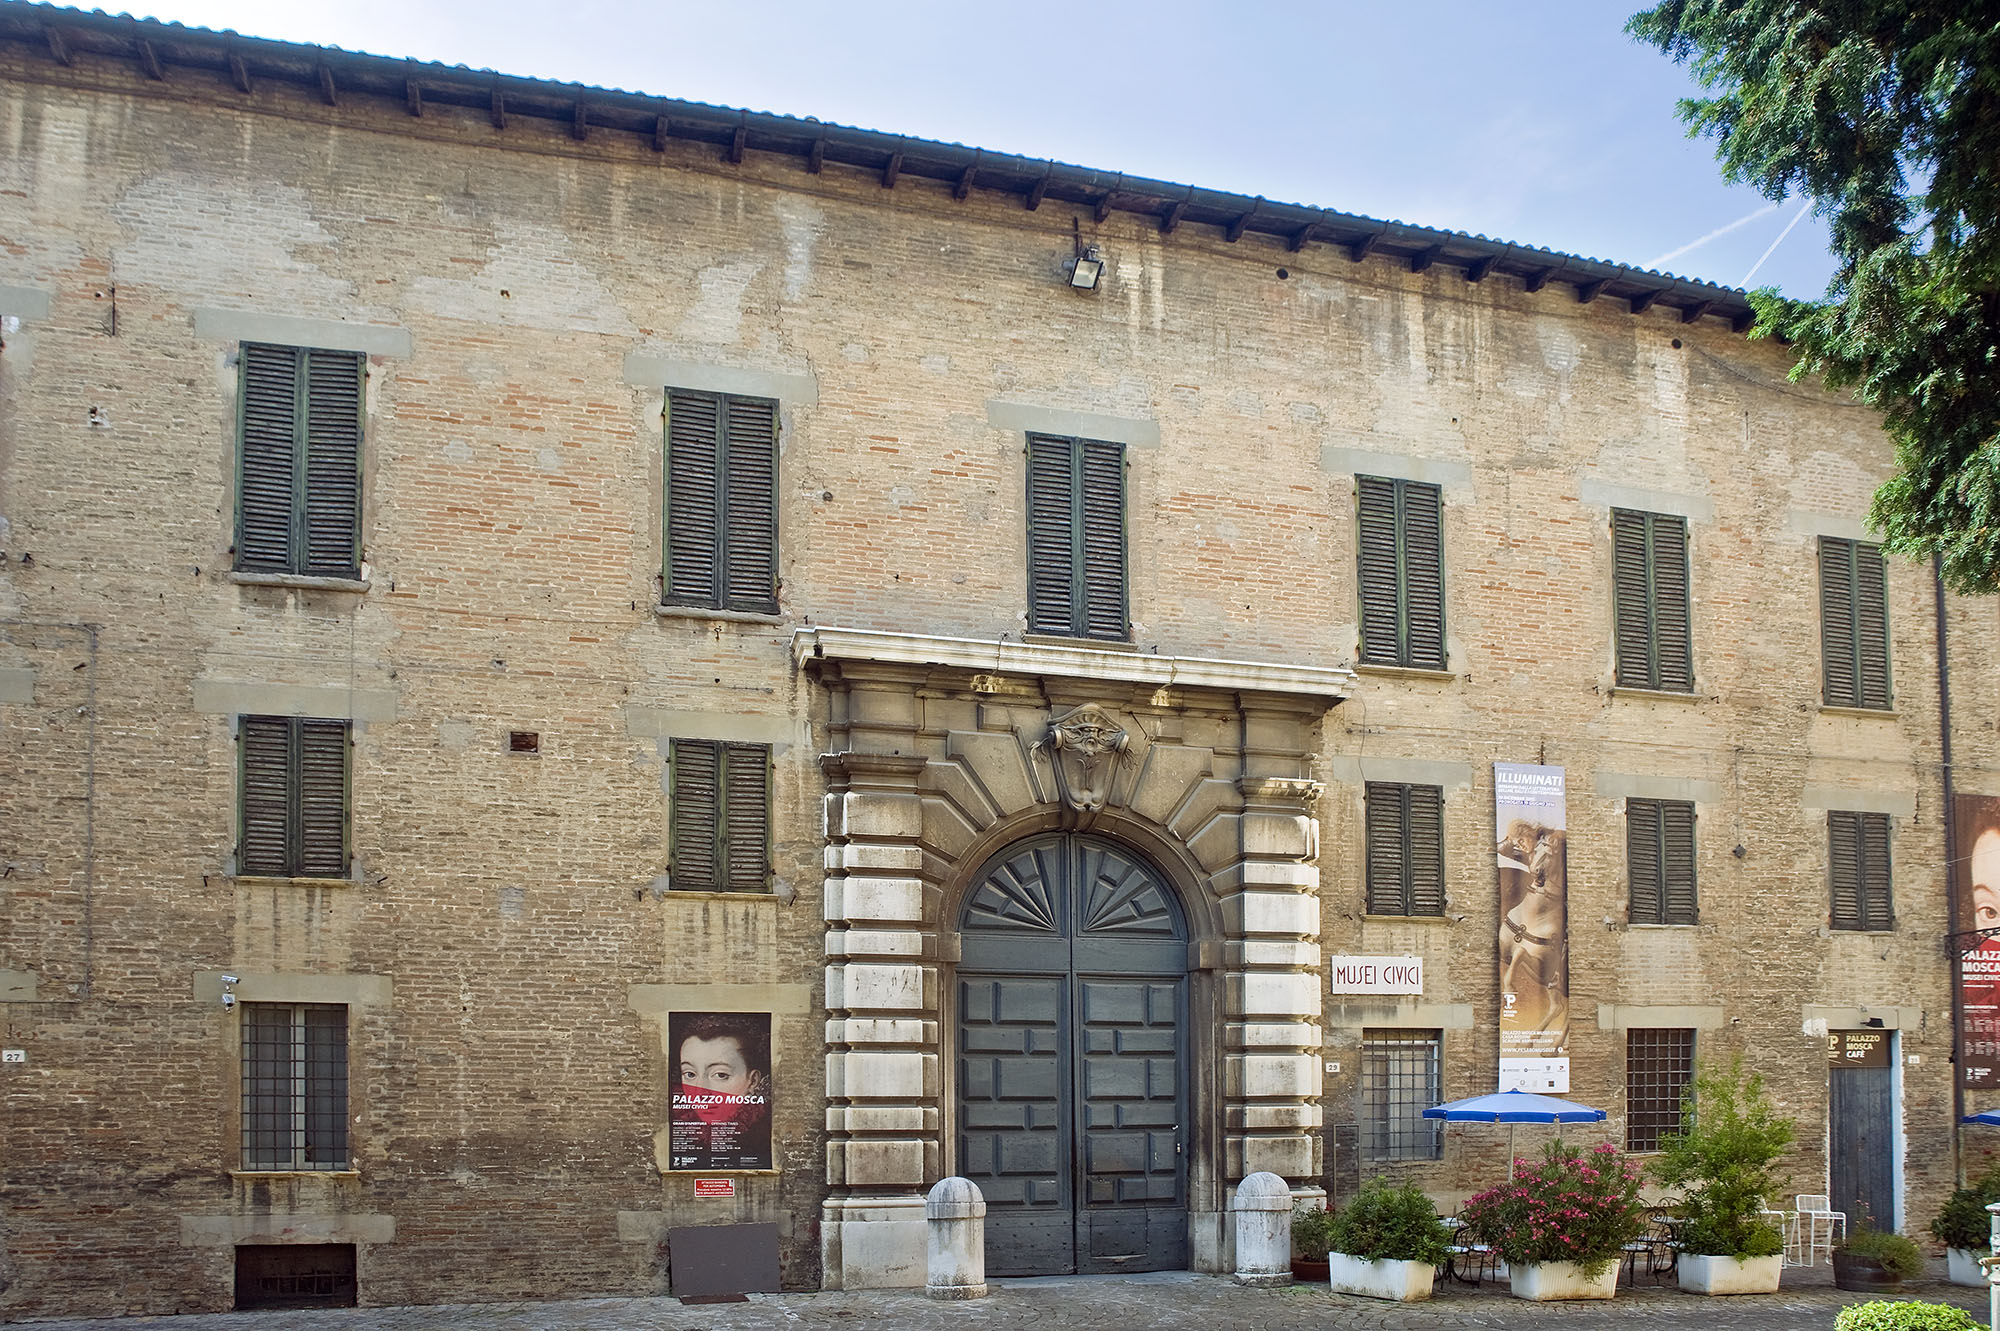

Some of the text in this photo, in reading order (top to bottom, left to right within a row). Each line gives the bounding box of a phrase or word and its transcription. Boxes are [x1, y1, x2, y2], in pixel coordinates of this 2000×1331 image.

[1498, 773, 1562, 786] ILLUMINATI
[1336, 966, 1419, 985] MUSEI CIVICI
[6, 1053, 20, 1061] 27
[1846, 1049, 1866, 1058] CAFÈ
[673, 1095, 765, 1104] PALAZZO MOSCA
